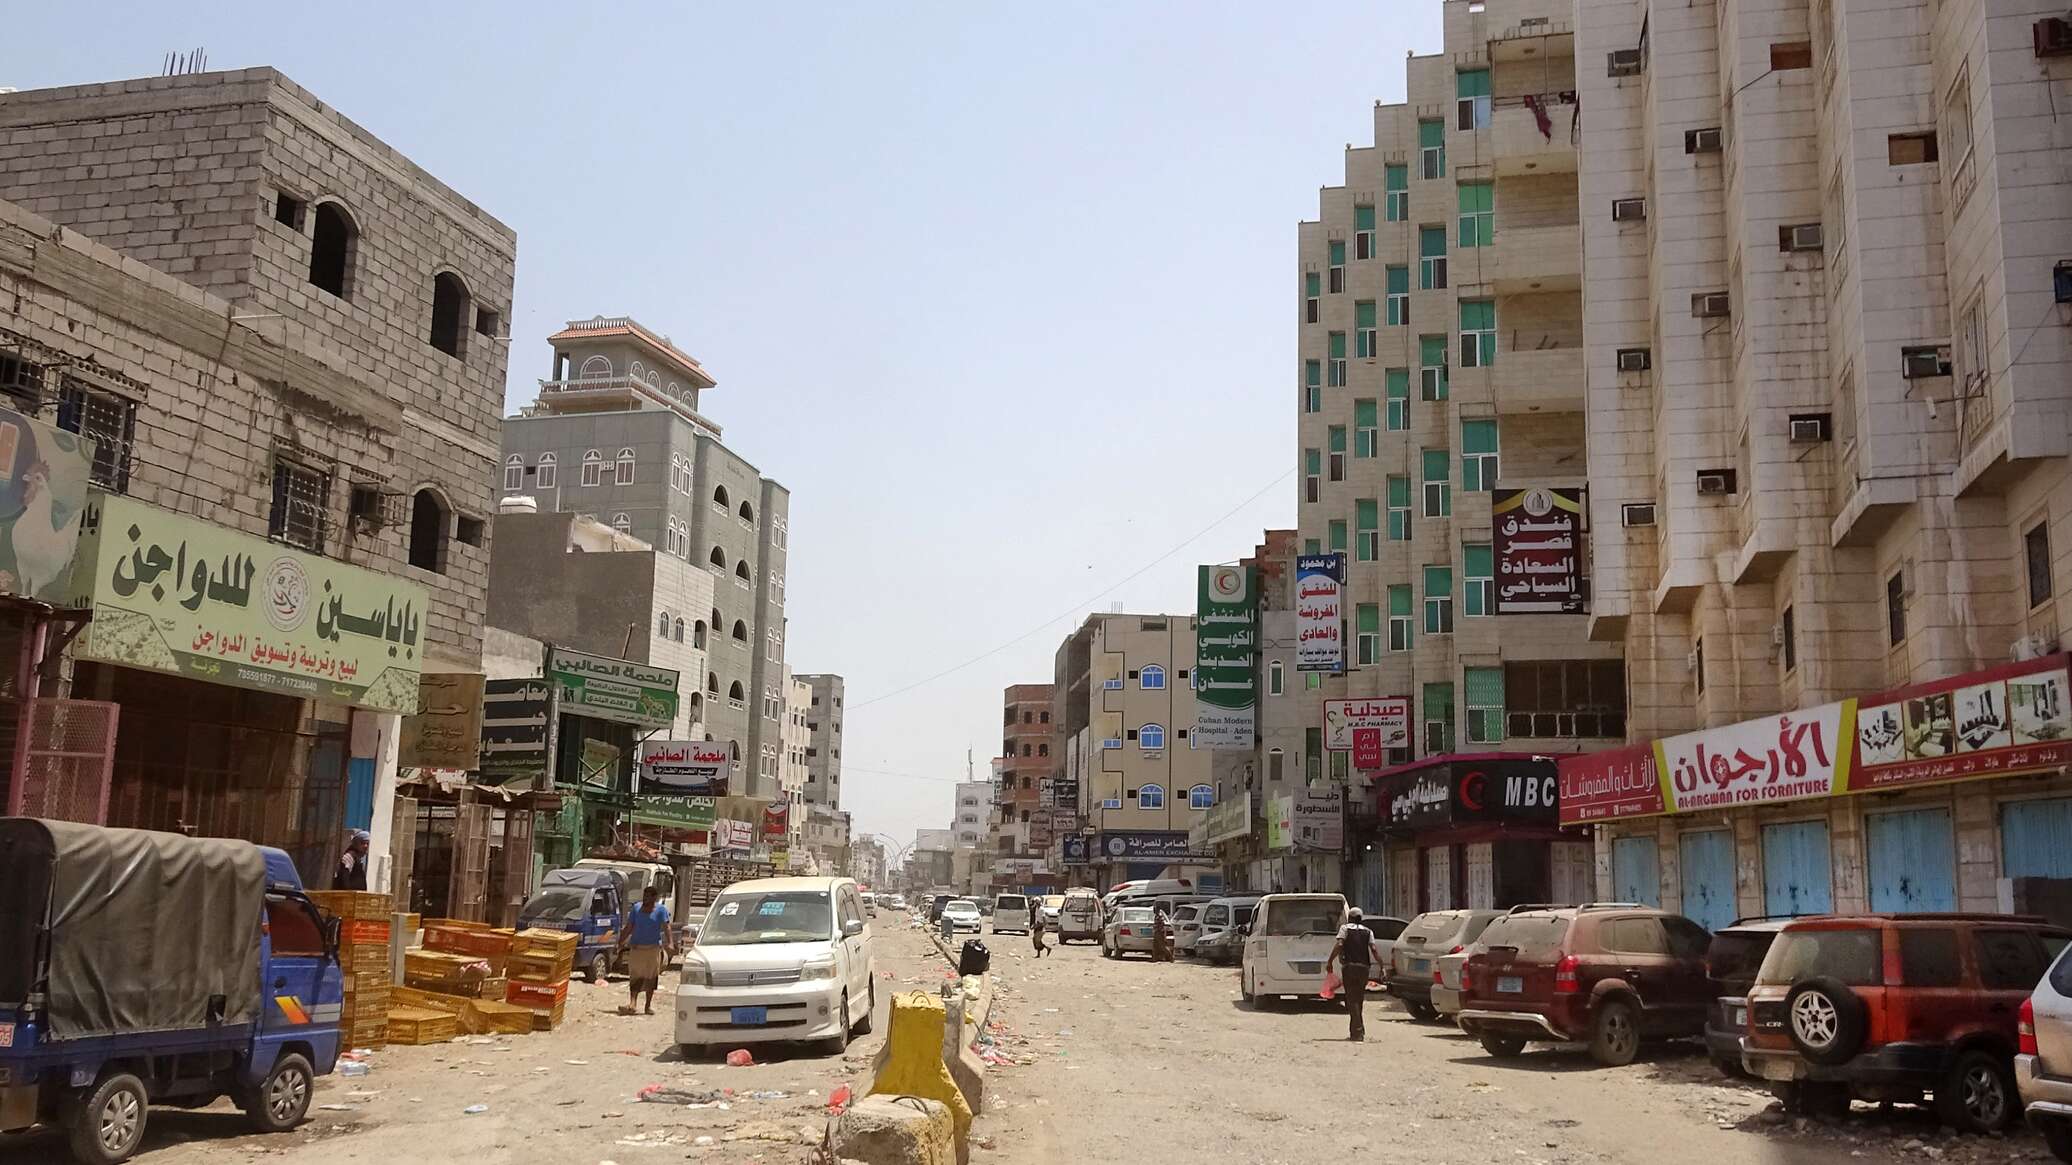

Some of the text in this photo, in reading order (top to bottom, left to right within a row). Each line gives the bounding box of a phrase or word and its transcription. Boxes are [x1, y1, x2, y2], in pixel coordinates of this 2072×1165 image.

[1501, 514, 1572, 536] فندق
[1502, 532, 1572, 554] قصر
[112, 523, 256, 611] للدواجن
[1501, 556, 1574, 574] السعادة
[1299, 583, 1336, 599] للشقق
[1500, 576, 1576, 600] السياحي
[192, 625, 247, 656] الدواجن
[249, 636, 297, 668] وتسويق
[1198, 677, 1253, 692] عدن
[1224, 716, 1252, 724] Modern
[1343, 702, 1403, 721] صيدلية
[1198, 726, 1228, 735] Hospital
[1233, 727, 1253, 735] Aden
[693, 745, 727, 761] ملحمة
[1674, 716, 1831, 793] الأرجوان
[1621, 754, 1655, 792] للأثاث
[1505, 776, 1556, 807] MBC
[1678, 779, 1829, 809] AL-ARGWAN FOR FORNITURE
[1128, 837, 1161, 849] للصرافة
